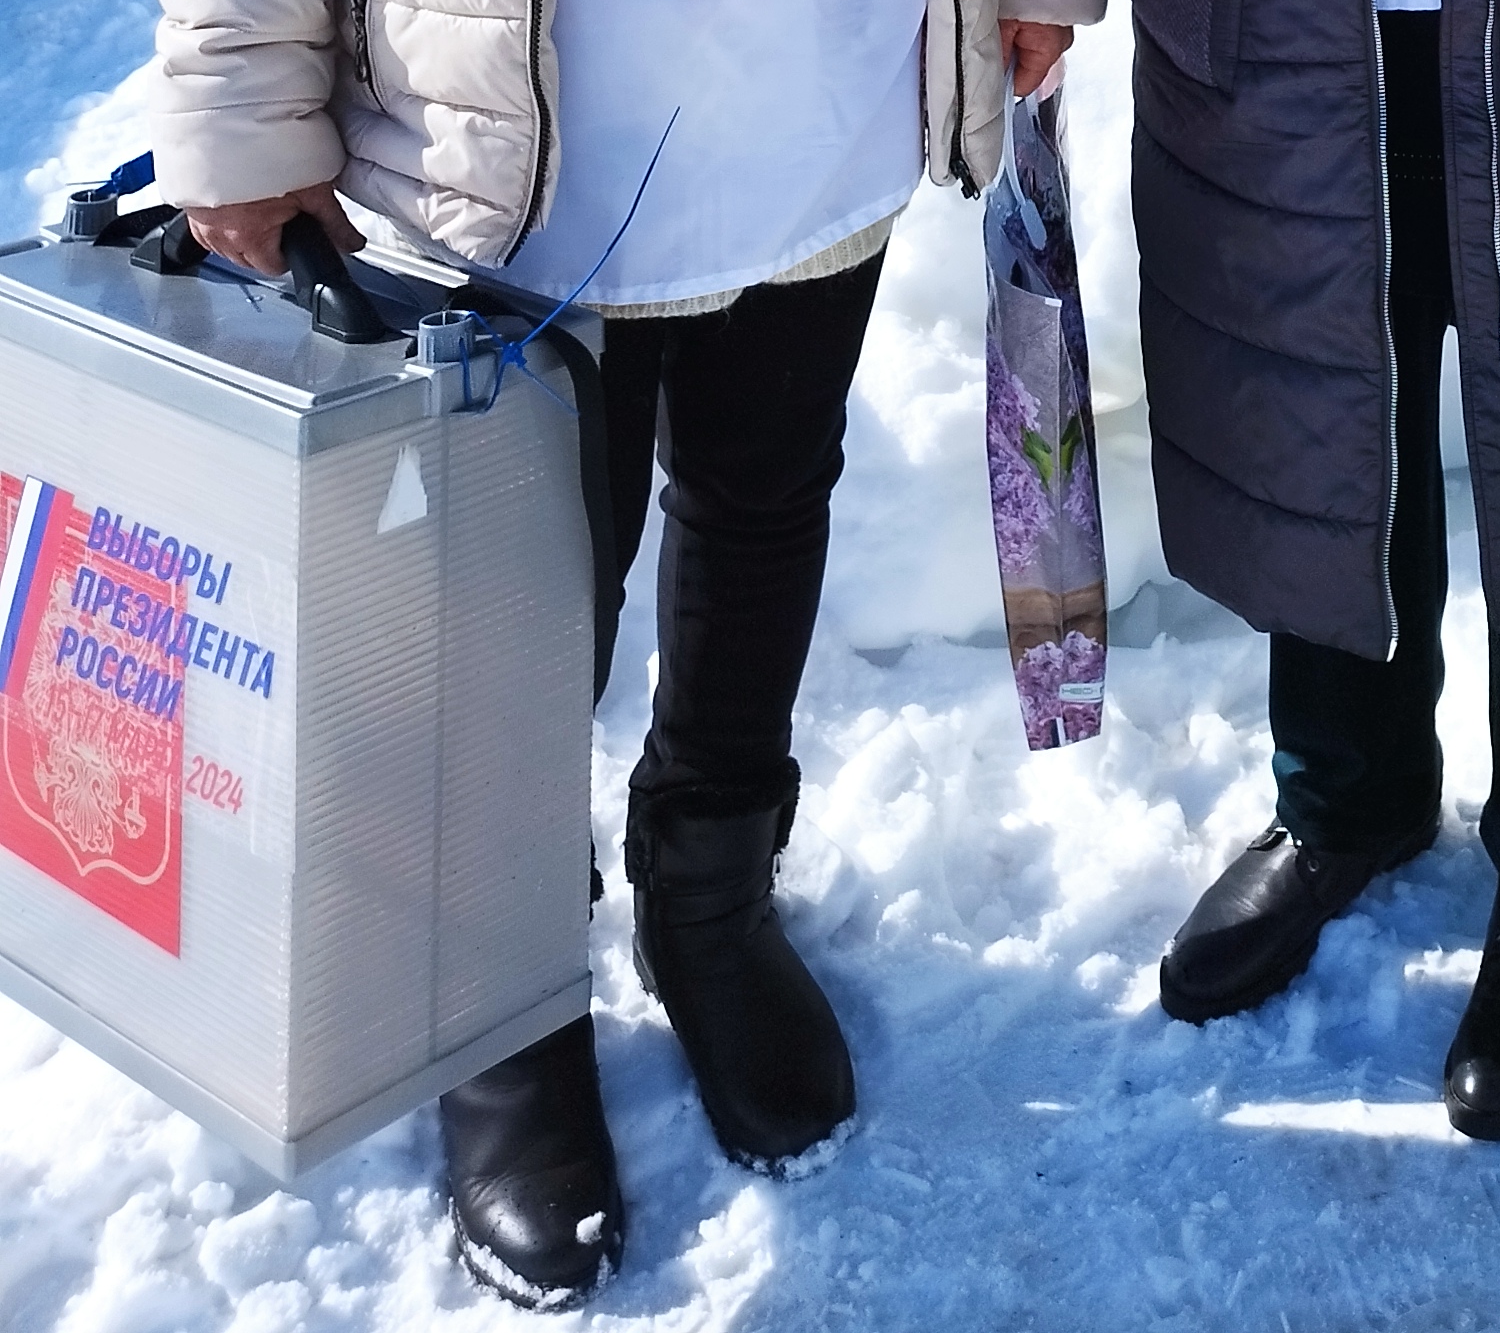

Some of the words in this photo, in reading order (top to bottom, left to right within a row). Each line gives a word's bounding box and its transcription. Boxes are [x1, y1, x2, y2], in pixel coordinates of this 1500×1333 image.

[88, 506, 232, 605] ВЫБОРЫ
[56, 625, 183, 722] РОССИИ
[71, 566, 276, 699] ПРЕЗИДЕНТА
[185, 755, 244, 815] 2024
